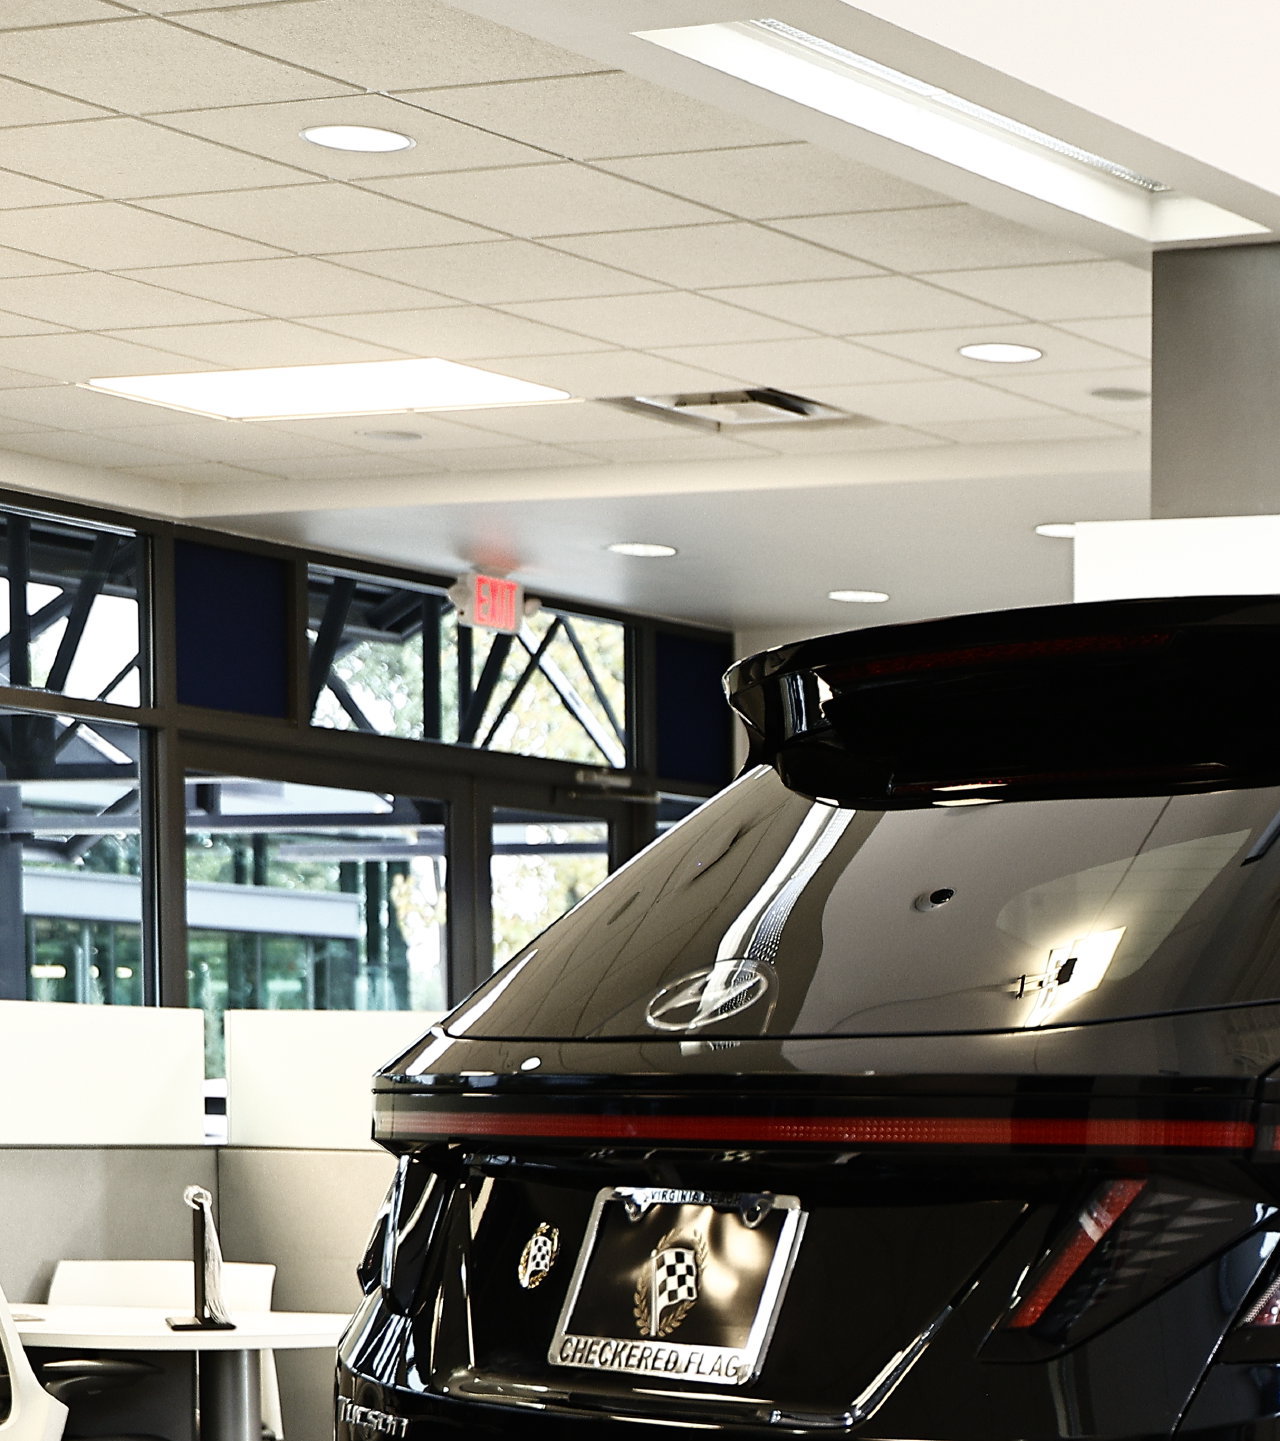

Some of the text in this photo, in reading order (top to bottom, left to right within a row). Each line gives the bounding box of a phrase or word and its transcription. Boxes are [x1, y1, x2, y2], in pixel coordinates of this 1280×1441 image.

[474, 574, 518, 631] EXIT
[651, 1189, 700, 1203] VIRGINIA
[559, 1337, 740, 1378] CHECKERED FLAG
